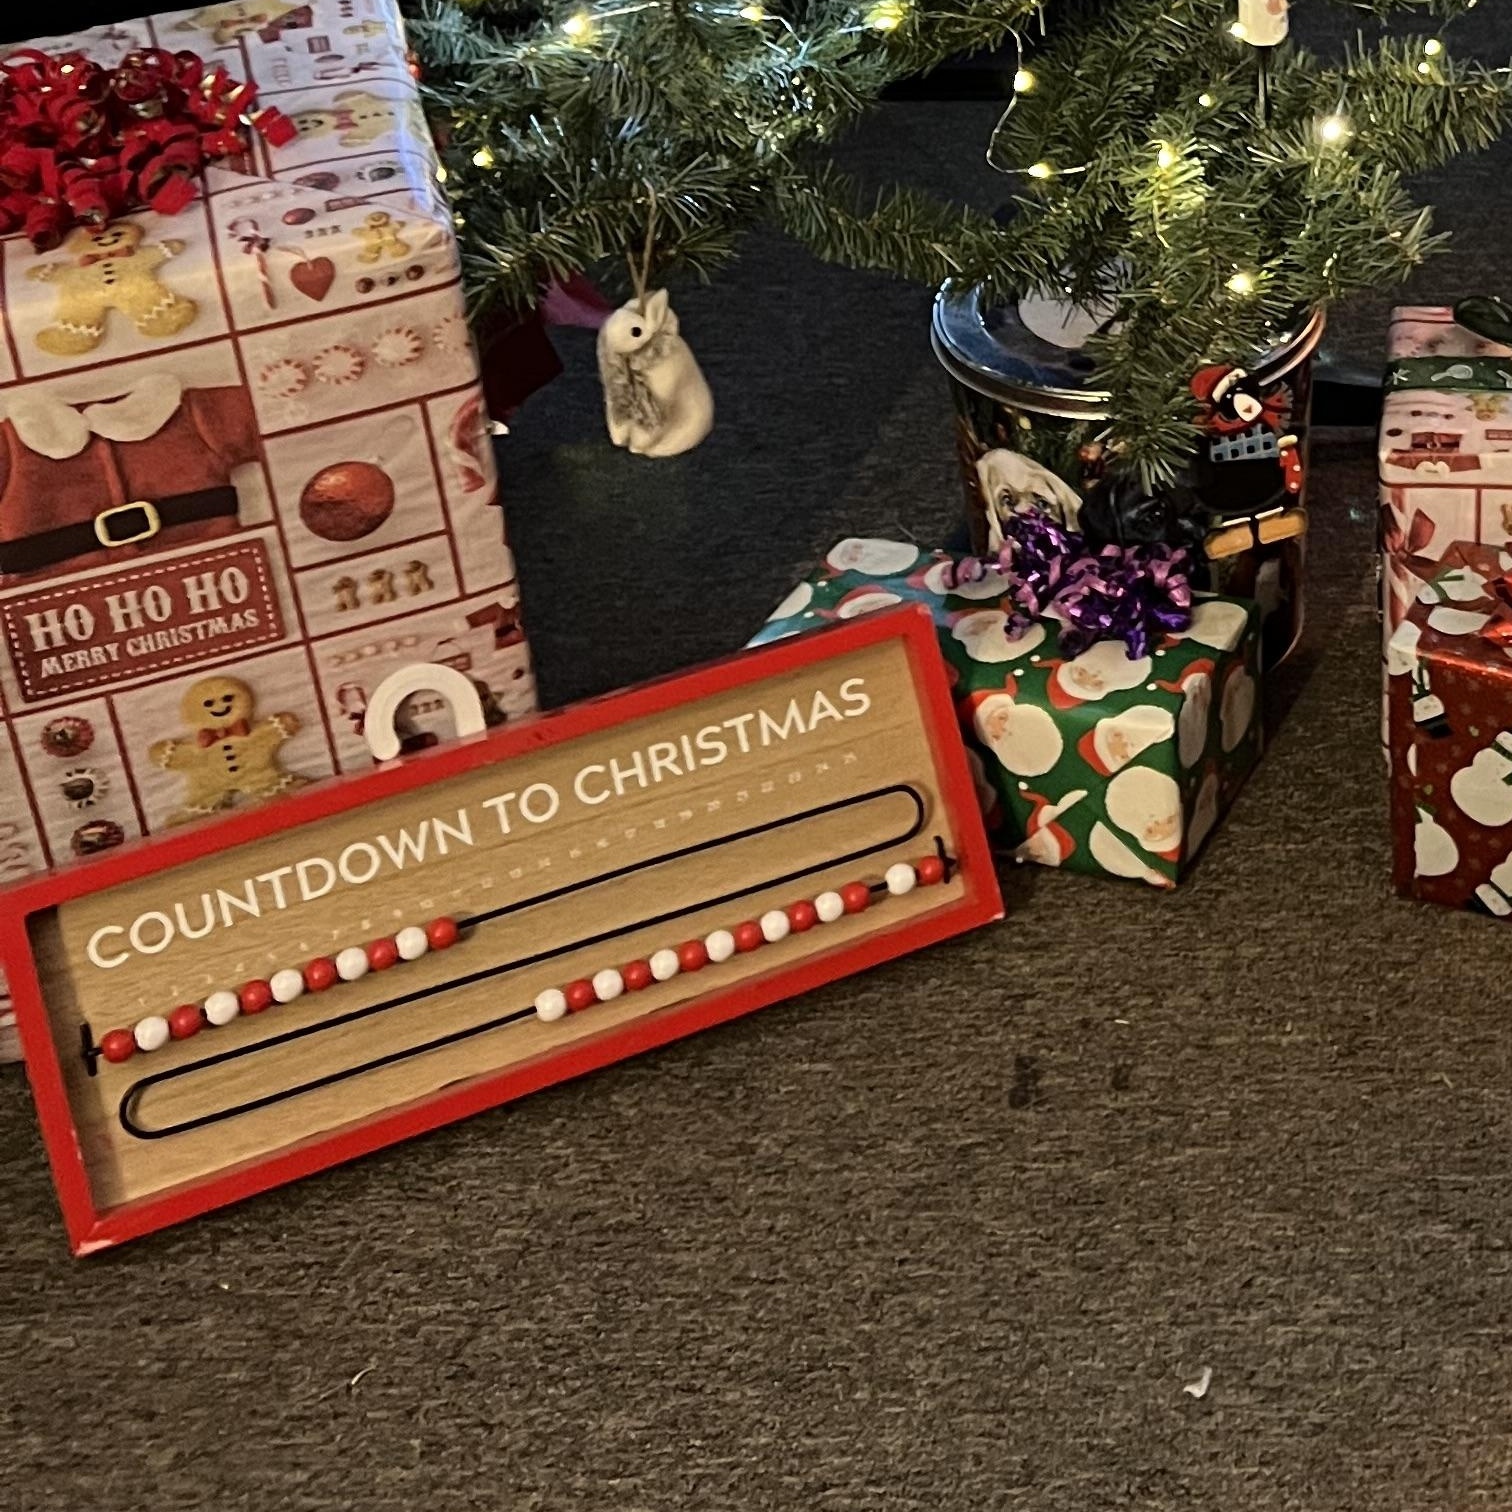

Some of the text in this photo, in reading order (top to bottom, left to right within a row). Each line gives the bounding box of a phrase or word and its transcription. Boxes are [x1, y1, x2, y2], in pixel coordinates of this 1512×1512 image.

[24, 566, 249, 652] HO HO HO
[41, 608, 261, 679] MERRY CHRISTMAS
[86, 678, 871, 969] COUNTDOWN TO CHRISTMAS
